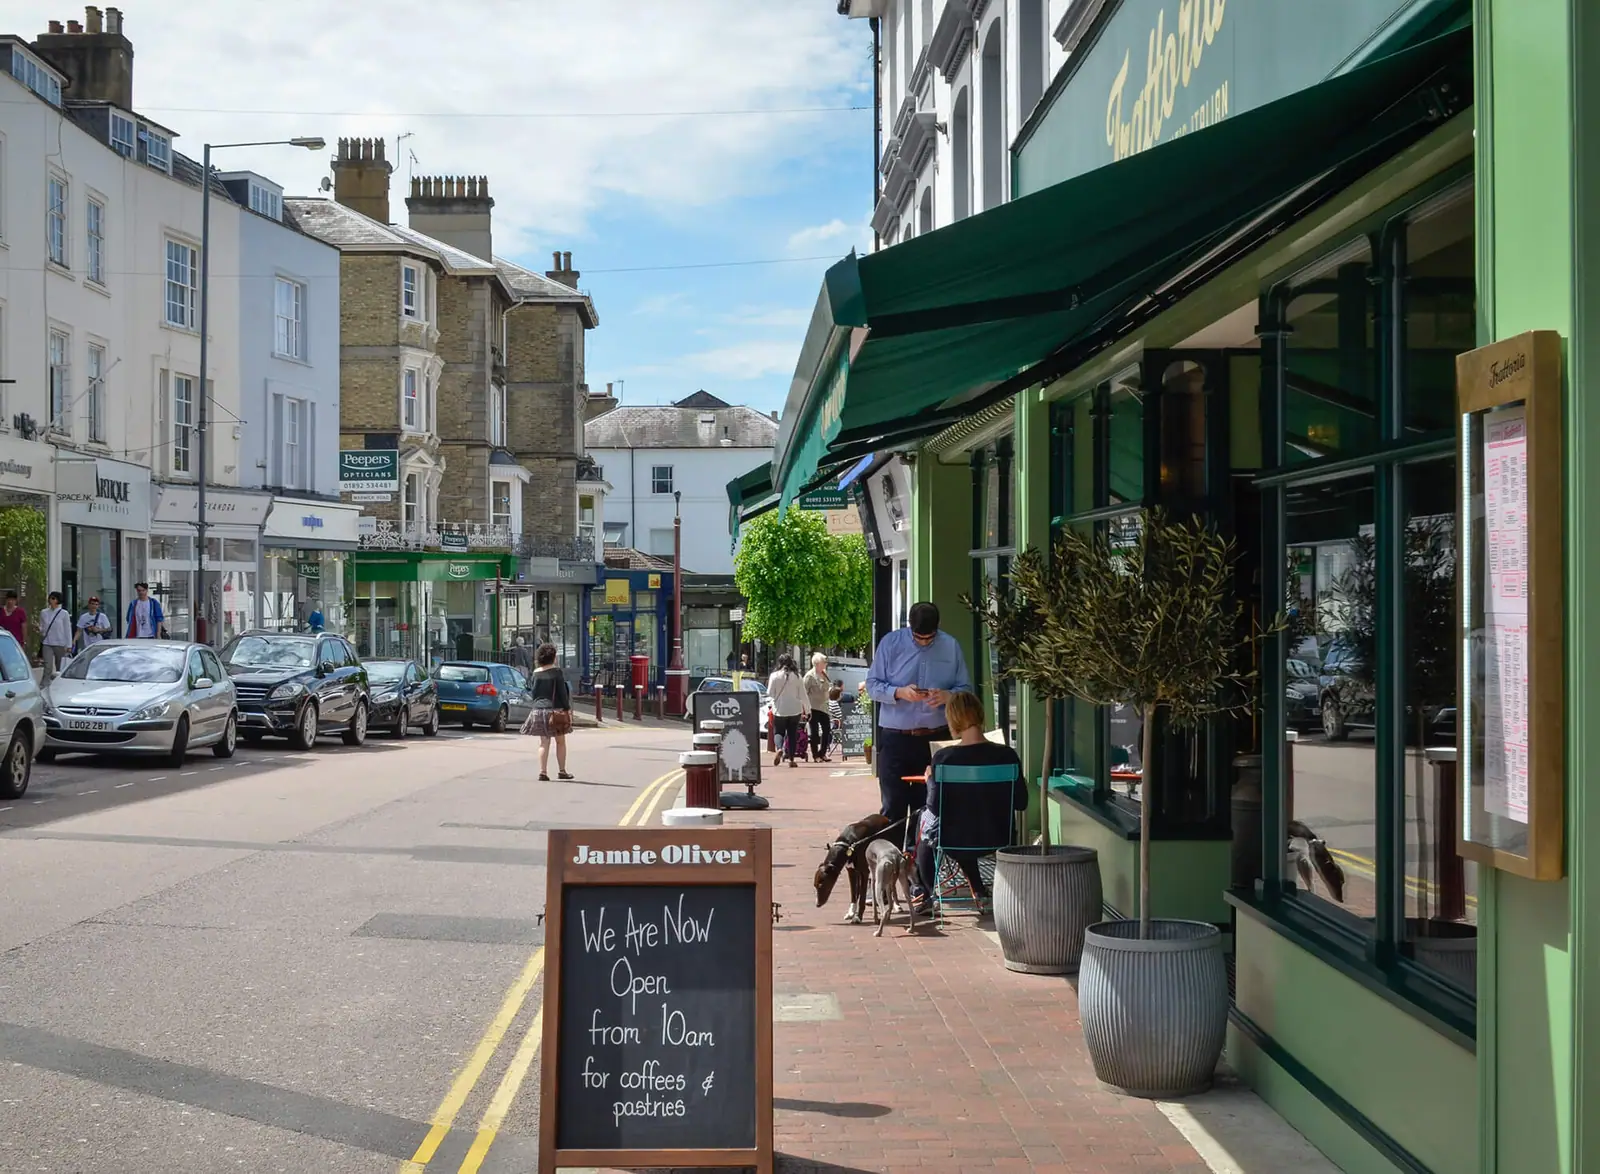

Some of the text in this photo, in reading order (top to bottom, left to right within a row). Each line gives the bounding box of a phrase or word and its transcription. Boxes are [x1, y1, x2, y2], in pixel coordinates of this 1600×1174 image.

[1191, 80, 1228, 132] ITALIAN
[1489, 352, 1525, 388] Trattoria
[344, 454, 391, 467] Peepers
[449, 564, 469, 574] Peepers
[92, 721, 108, 730] ZBT
[573, 844, 746, 865] Jamie Oliver
[580, 893, 714, 956] We Are Now
[610, 955, 671, 1015] Open
[588, 1002, 715, 1046] from 10am
[581, 1055, 610, 1089] for
[620, 1059, 686, 1091] coffees
[613, 1092, 686, 1128] pastries
